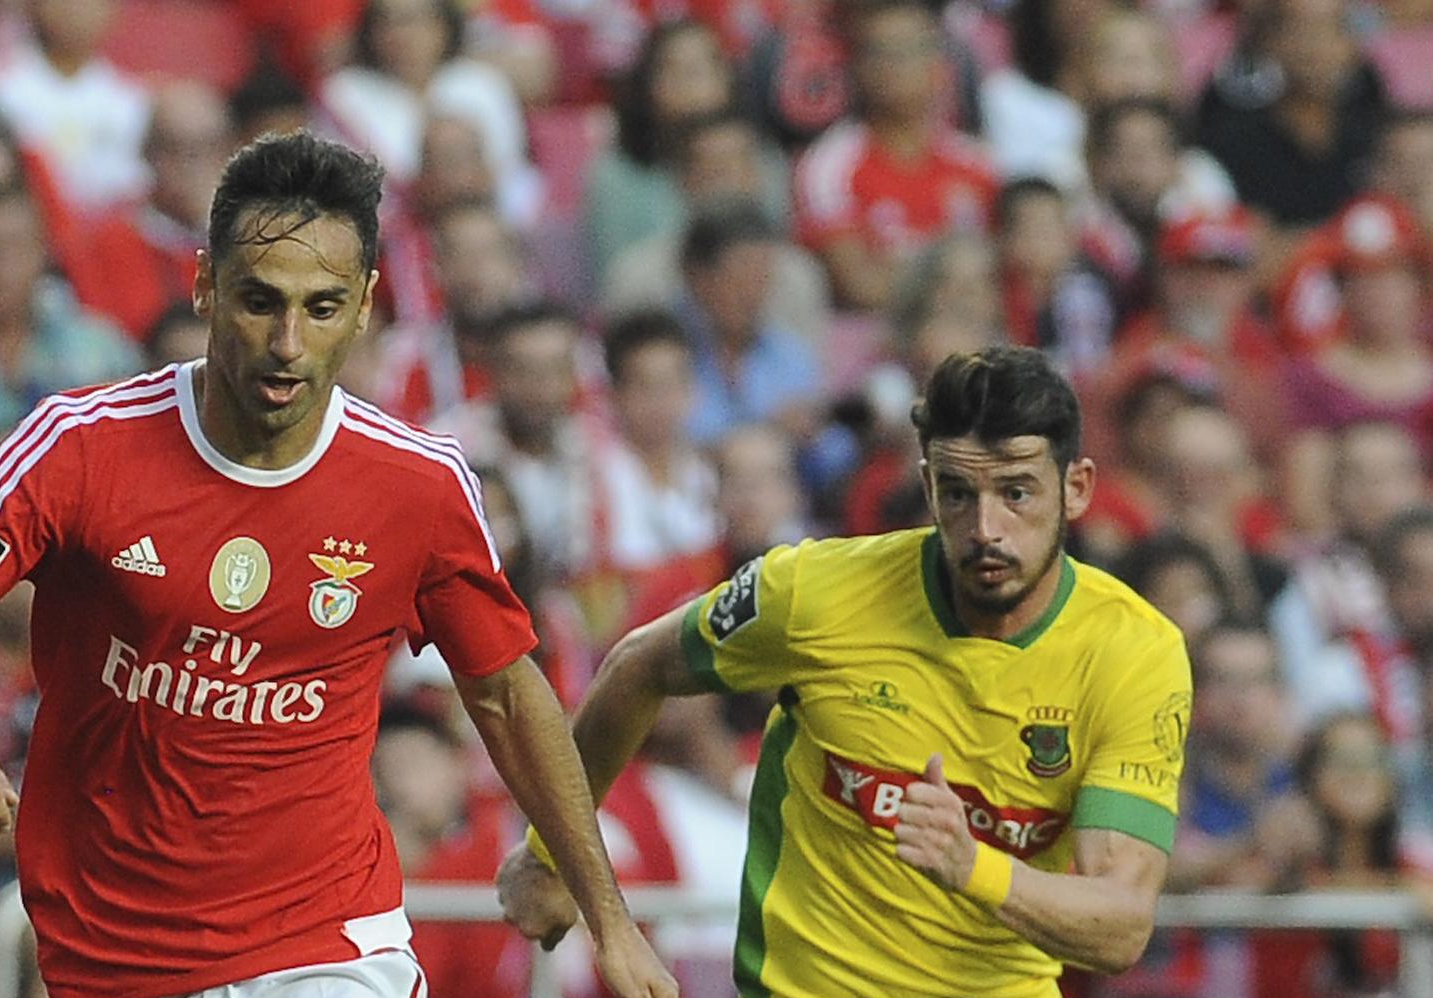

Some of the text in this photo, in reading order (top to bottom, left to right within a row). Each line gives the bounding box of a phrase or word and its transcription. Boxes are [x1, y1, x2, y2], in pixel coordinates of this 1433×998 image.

[111, 556, 166, 578] adidas
[182, 624, 262, 676] Fly
[101, 634, 327, 725] Emirates
